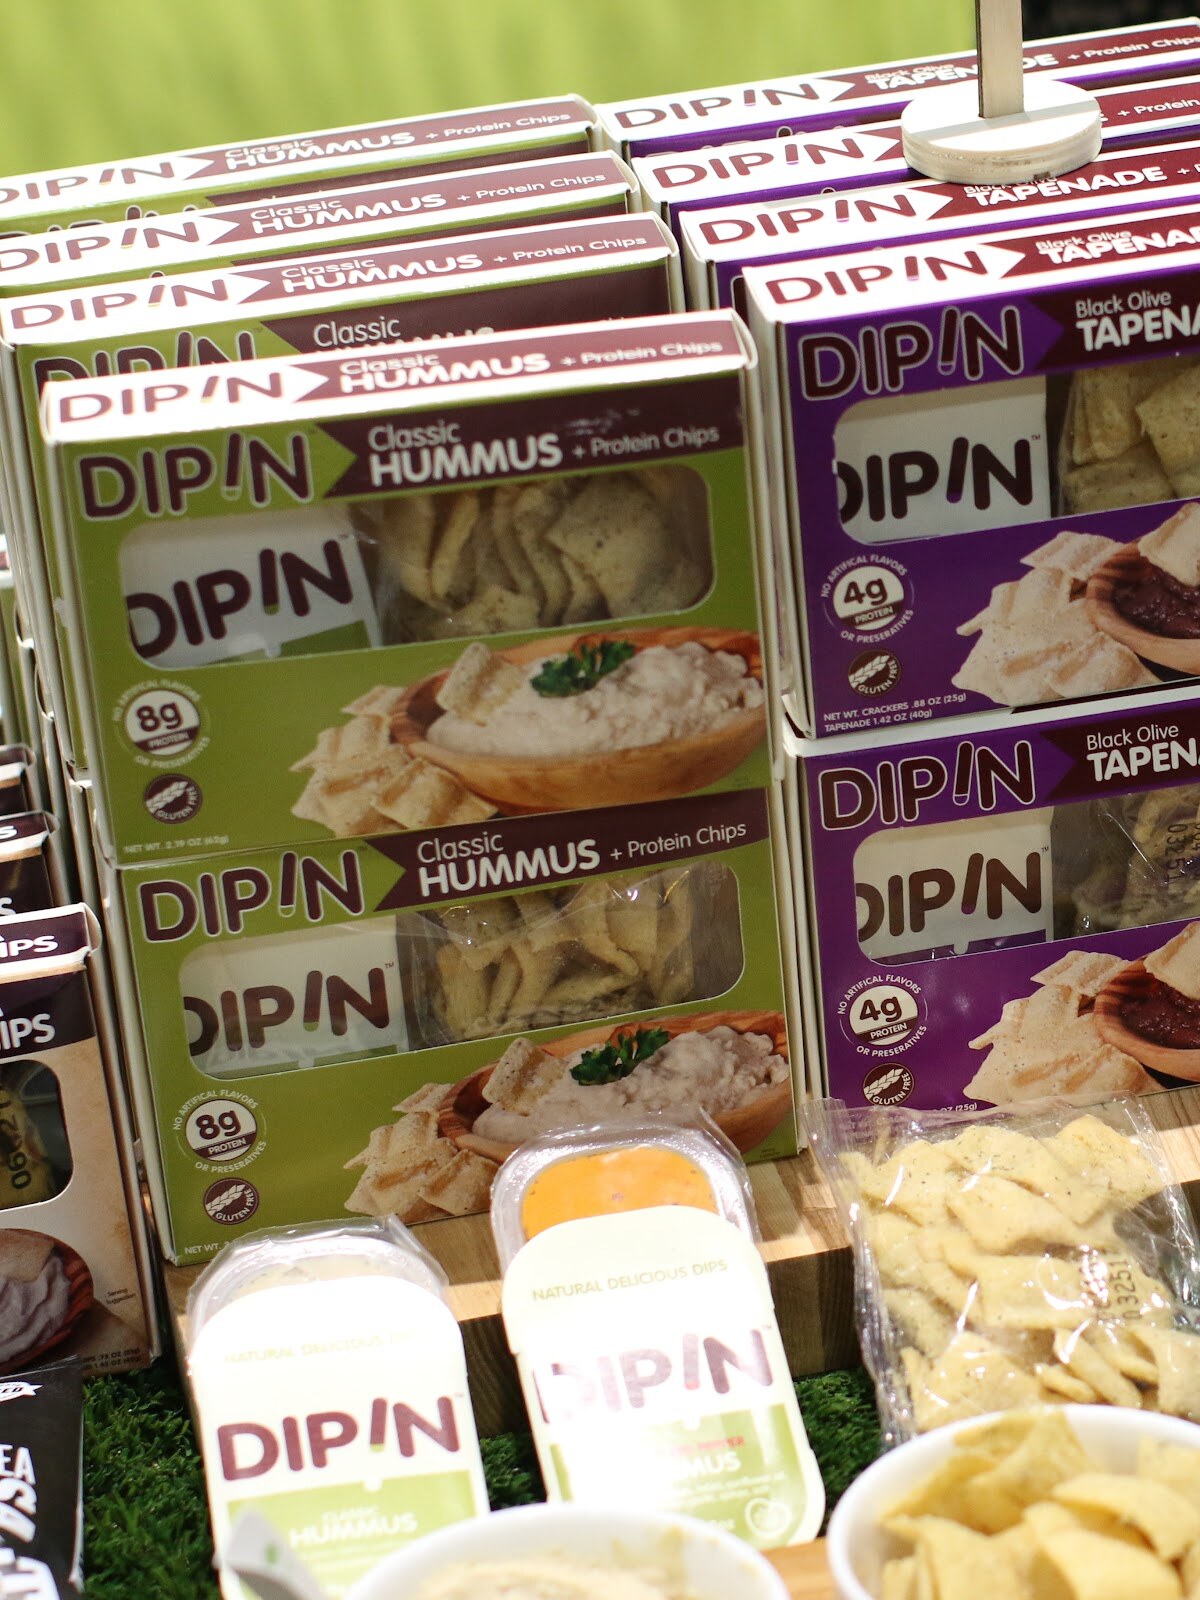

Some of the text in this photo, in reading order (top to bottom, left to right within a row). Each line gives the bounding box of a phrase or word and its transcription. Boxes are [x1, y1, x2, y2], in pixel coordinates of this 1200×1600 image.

[1084, 40, 1149, 58] Protein
[1134, 94, 1199, 114] Protein
[224, 137, 313, 158] Classic
[227, 112, 571, 172] HUMMUS Protein Chips
[966, 166, 1168, 207] TAPENADE
[250, 200, 344, 220] Classic
[253, 194, 447, 235] HUMMUS
[474, 181, 546, 200] Protein
[551, 172, 606, 190] Chips
[281, 259, 376, 278] Classic
[284, 253, 484, 292] HUMMUS
[513, 245, 585, 262] Protein
[590, 235, 648, 253] Chips
[1076, 290, 1171, 319] Black Olive
[312, 316, 401, 349] Classic
[341, 352, 440, 374] Classic
[341, 353, 550, 392] HUMMUS
[581, 347, 657, 365] Protein
[659, 341, 723, 357] Chips
[368, 421, 461, 451] Classic
[369, 433, 563, 487] HUMMUS
[591, 434, 660, 457] Protein
[664, 424, 720, 448] Chips
[870, 555, 907, 576] FLAVORS
[843, 578, 888, 605] 4g
[855, 606, 893, 624] PROTEIN
[141, 702, 184, 732] 8g
[1087, 724, 1179, 751] Black Olive
[417, 831, 503, 864] Classic
[418, 839, 600, 897] HUMMUS
[628, 834, 691, 859] Protein
[696, 823, 747, 847] Chips
[885, 974, 922, 995] FLAVORS
[859, 996, 903, 1023] 4g
[870, 1023, 908, 1040] PROTEIN
[220, 1089, 258, 1109] FLAVORS
[196, 1109, 241, 1140] 8g
[208, 1137, 247, 1155] PROTEIN
[532, 1266, 688, 1302] NATURAL DELICIOUS
[289, 1512, 417, 1547] HUMMUS
